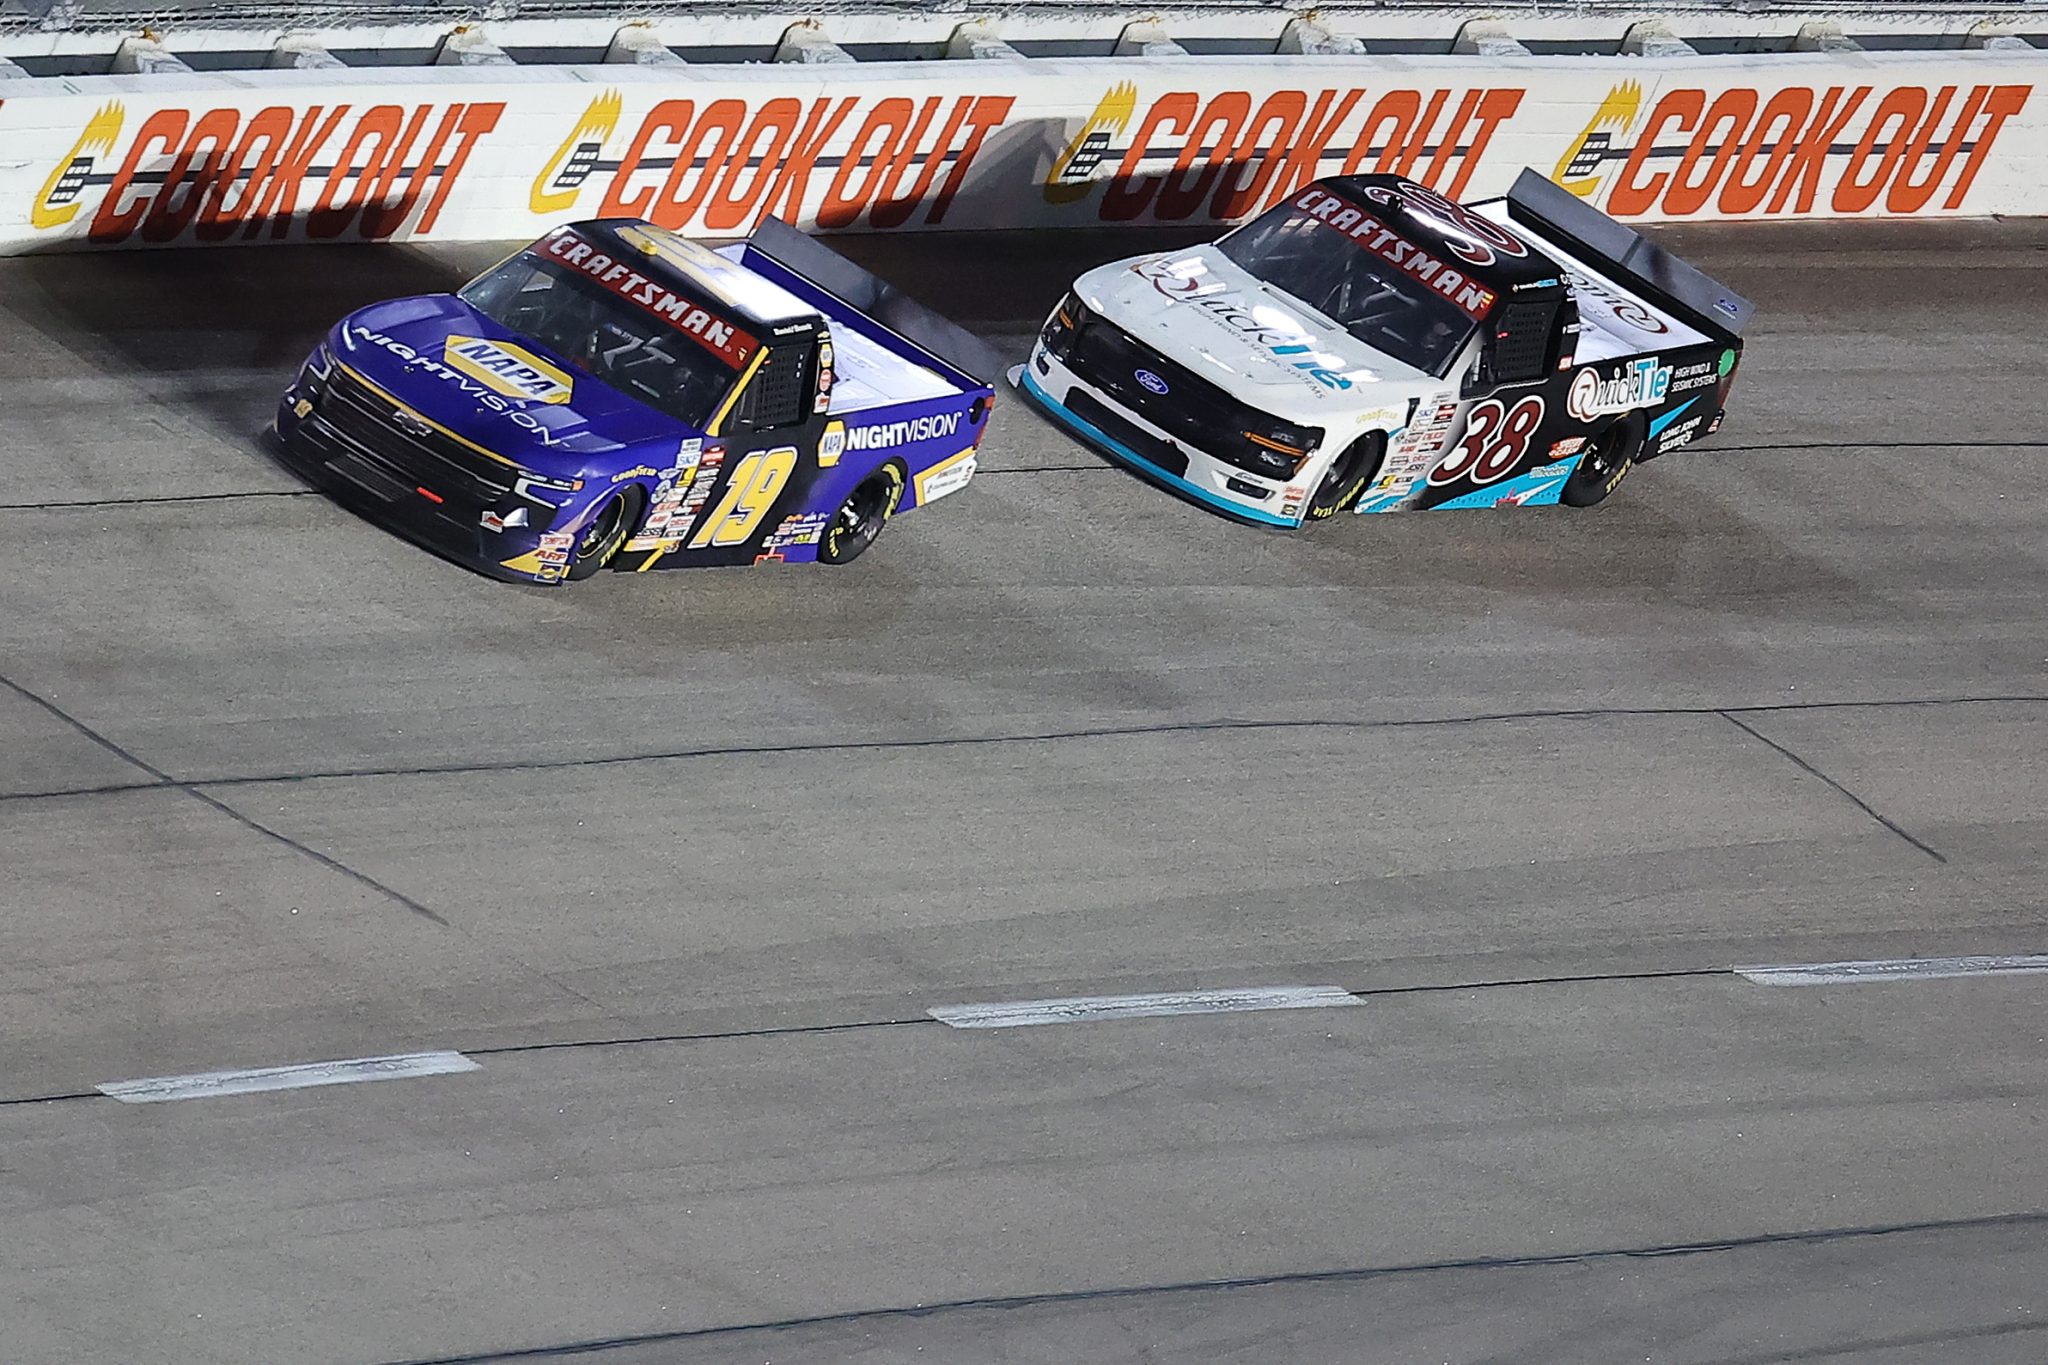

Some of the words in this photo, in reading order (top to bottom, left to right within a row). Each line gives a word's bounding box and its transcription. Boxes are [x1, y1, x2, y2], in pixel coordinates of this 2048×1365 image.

[549, 235, 734, 348] CRAFTSMAN
[1296, 190, 1486, 312] CRAFTSMAN
[352, 327, 561, 446] NIGHTVISION
[457, 344, 557, 395] NAPA
[1567, 356, 1669, 423] QuickTie
[846, 413, 958, 451] NIGHTVISION
[1427, 395, 1546, 487] 38
[687, 446, 798, 550] 19
[534, 549, 567, 562] ARP
